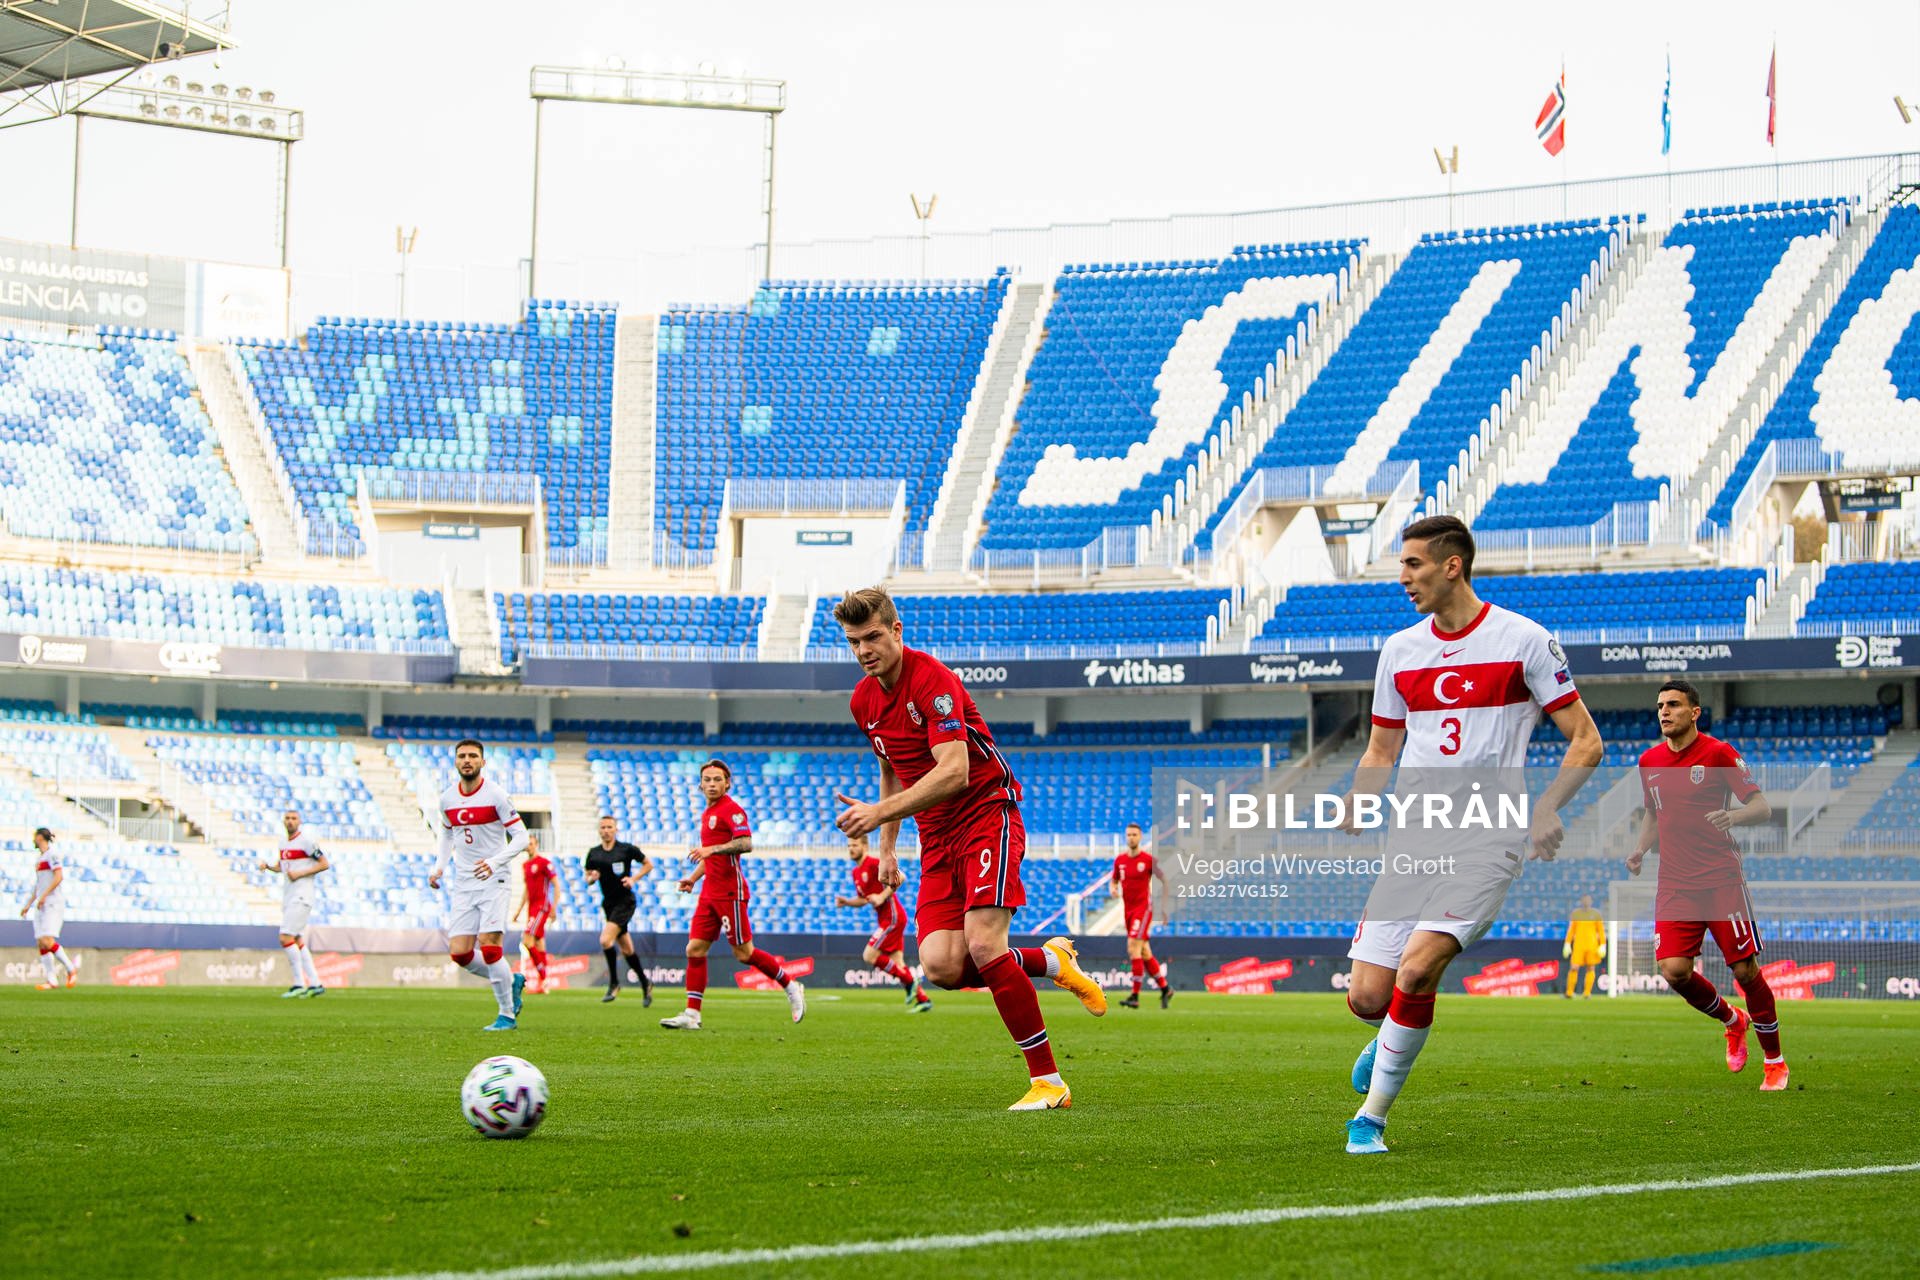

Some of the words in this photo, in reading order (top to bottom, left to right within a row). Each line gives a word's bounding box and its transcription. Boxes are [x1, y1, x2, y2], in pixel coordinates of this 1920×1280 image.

[20, 259, 149, 288] MALAGUISTAS
[97, 291, 148, 318] NO
[1601, 644, 1640, 662] DOÑA
[1641, 644, 1733, 661] FRANCISQUITA
[1645, 659, 1688, 671] catering
[1108, 659, 1186, 685] vithas
[1439, 717, 1462, 756] 3
[1650, 786, 1663, 810] 11
[464, 827, 474, 844] 5
[979, 848, 992, 878] 9
[721, 915, 731, 932] 8
[1728, 911, 1748, 938] 11
[206, 960, 258, 984] equinor
[626, 966, 685, 984] euinor
